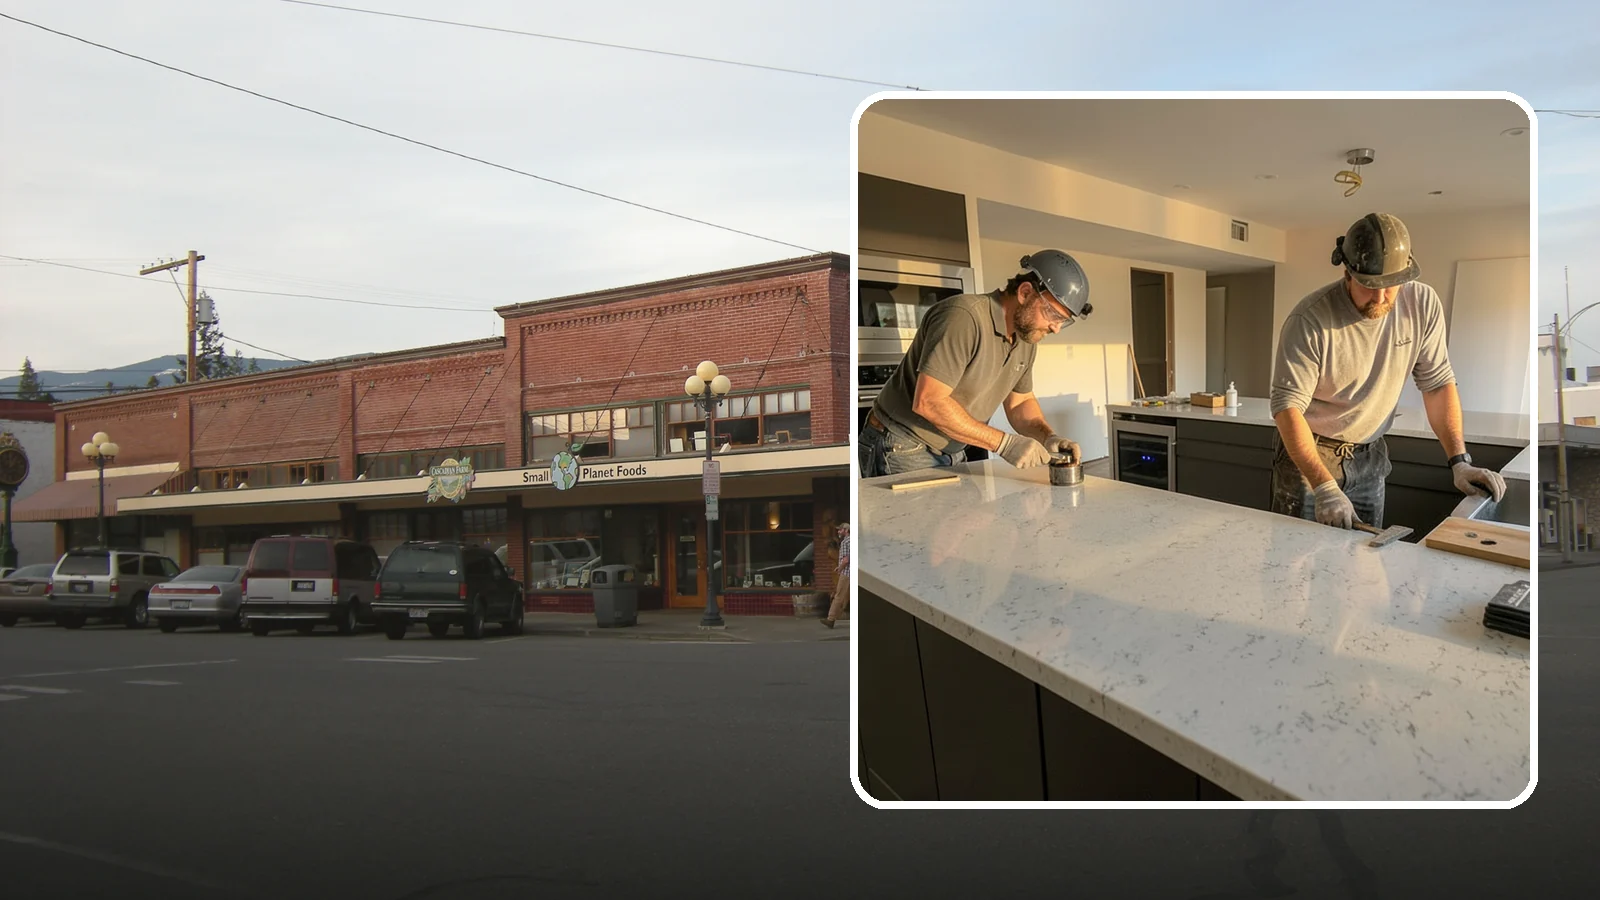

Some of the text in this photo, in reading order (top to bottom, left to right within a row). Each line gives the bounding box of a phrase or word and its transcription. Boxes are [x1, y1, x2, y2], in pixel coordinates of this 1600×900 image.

[523, 464, 647, 483] Small Planet Foods
